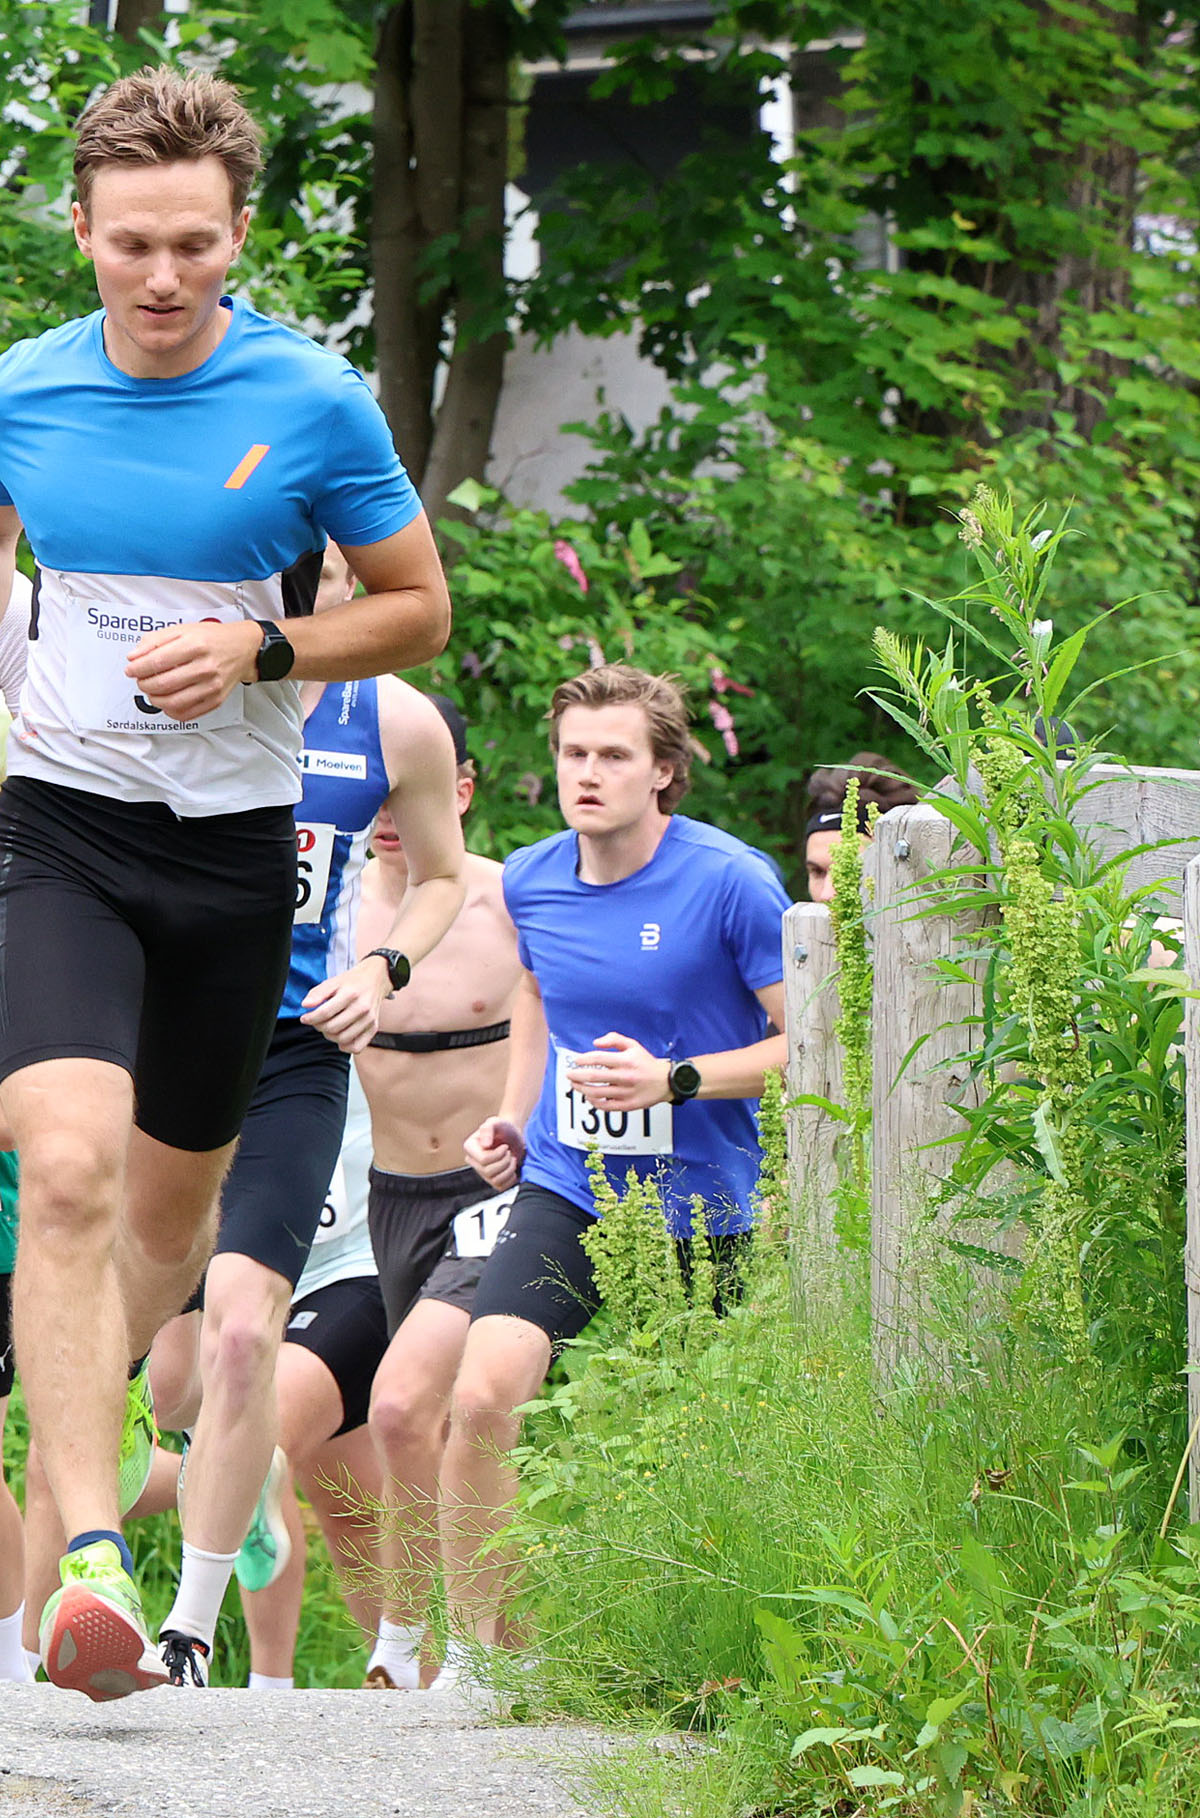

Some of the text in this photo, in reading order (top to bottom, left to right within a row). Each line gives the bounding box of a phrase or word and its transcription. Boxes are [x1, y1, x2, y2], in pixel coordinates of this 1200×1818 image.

[87, 607, 183, 632] SpareBa
[106, 719, 199, 731] Sørdalskarusellen
[316, 758, 362, 771] Moelven
